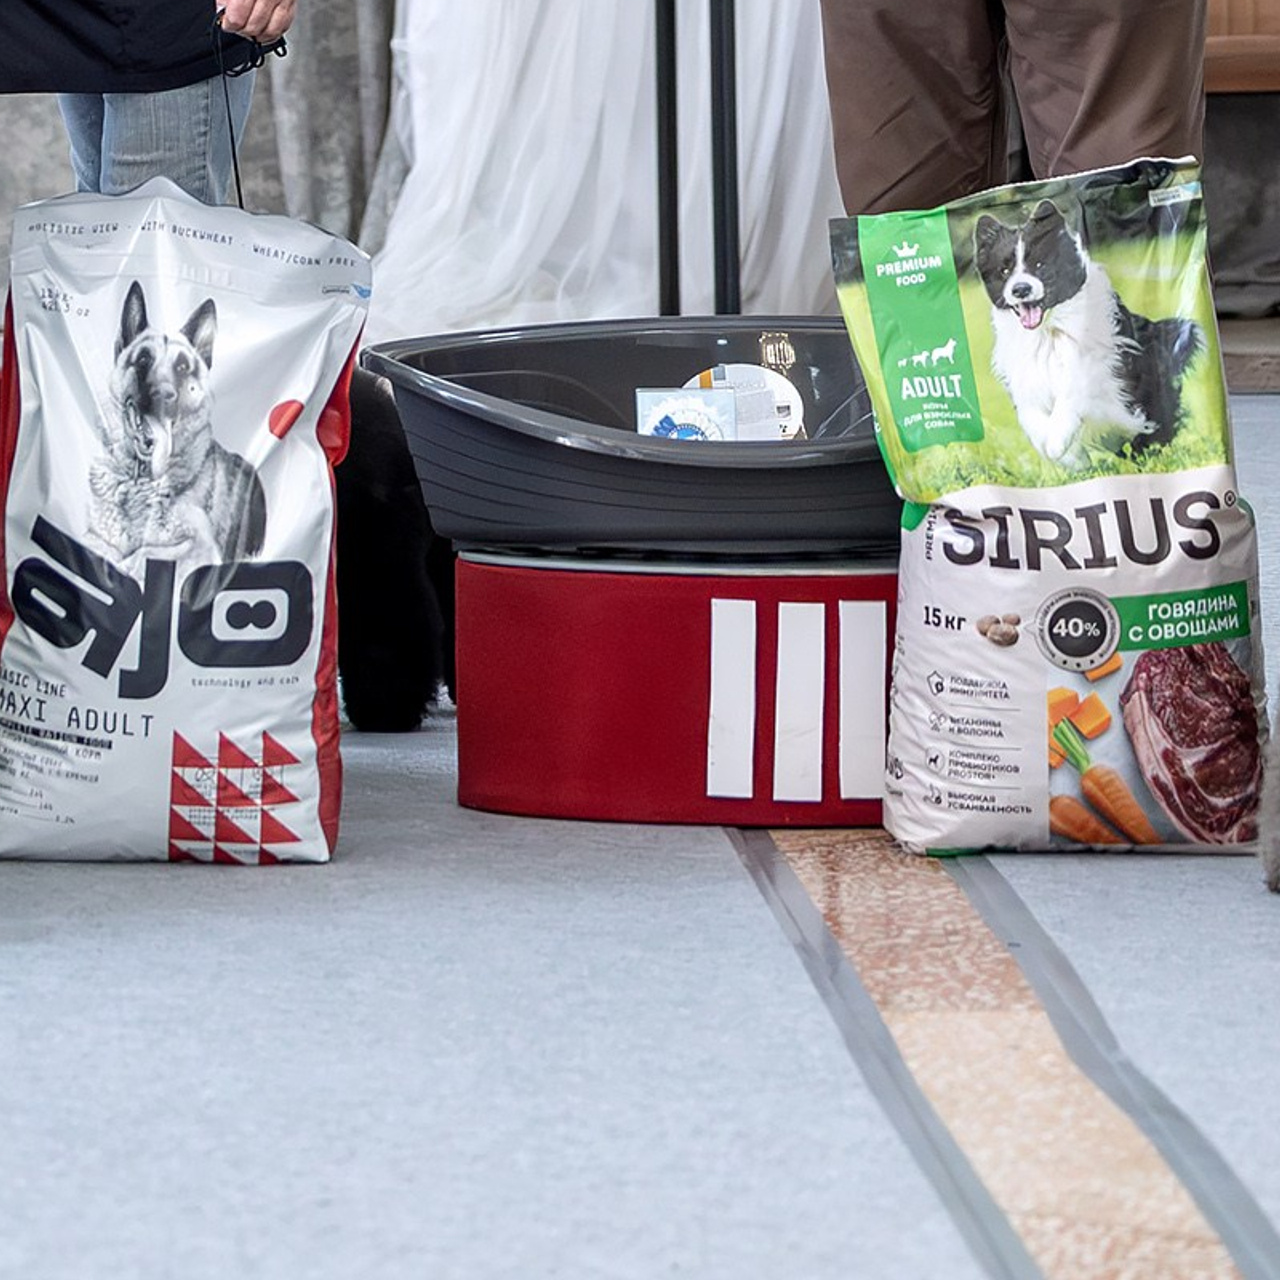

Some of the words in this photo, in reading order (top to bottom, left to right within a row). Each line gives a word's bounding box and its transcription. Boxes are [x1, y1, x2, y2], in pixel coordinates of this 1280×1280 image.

[172, 224, 233, 246] BUCKWHEAT
[876, 256, 942, 277] PREMIUM
[896, 273, 926, 287] FOOD
[901, 375, 962, 400] ADULT
[925, 504, 942, 561] PREMI
[923, 605, 941, 627] 15
[1148, 594, 1238, 621] ГОВЯДИНА
[1052, 616, 1101, 638] 40%
[1128, 626, 1144, 642] С
[1148, 614, 1240, 641] ОВОЩАМИ
[36, 679, 67, 699] LINE
[191, 678, 251, 689] technology
[67, 706, 154, 737] ADULT
[957, 727, 1004, 738] ВОЛОКНА
[949, 759, 1020, 774] ПРОБИОТИКОВ
[947, 791, 996, 803] ВЫСОКАЯ
[947, 801, 1033, 814] УСВАИВАЕМОСТЬ
